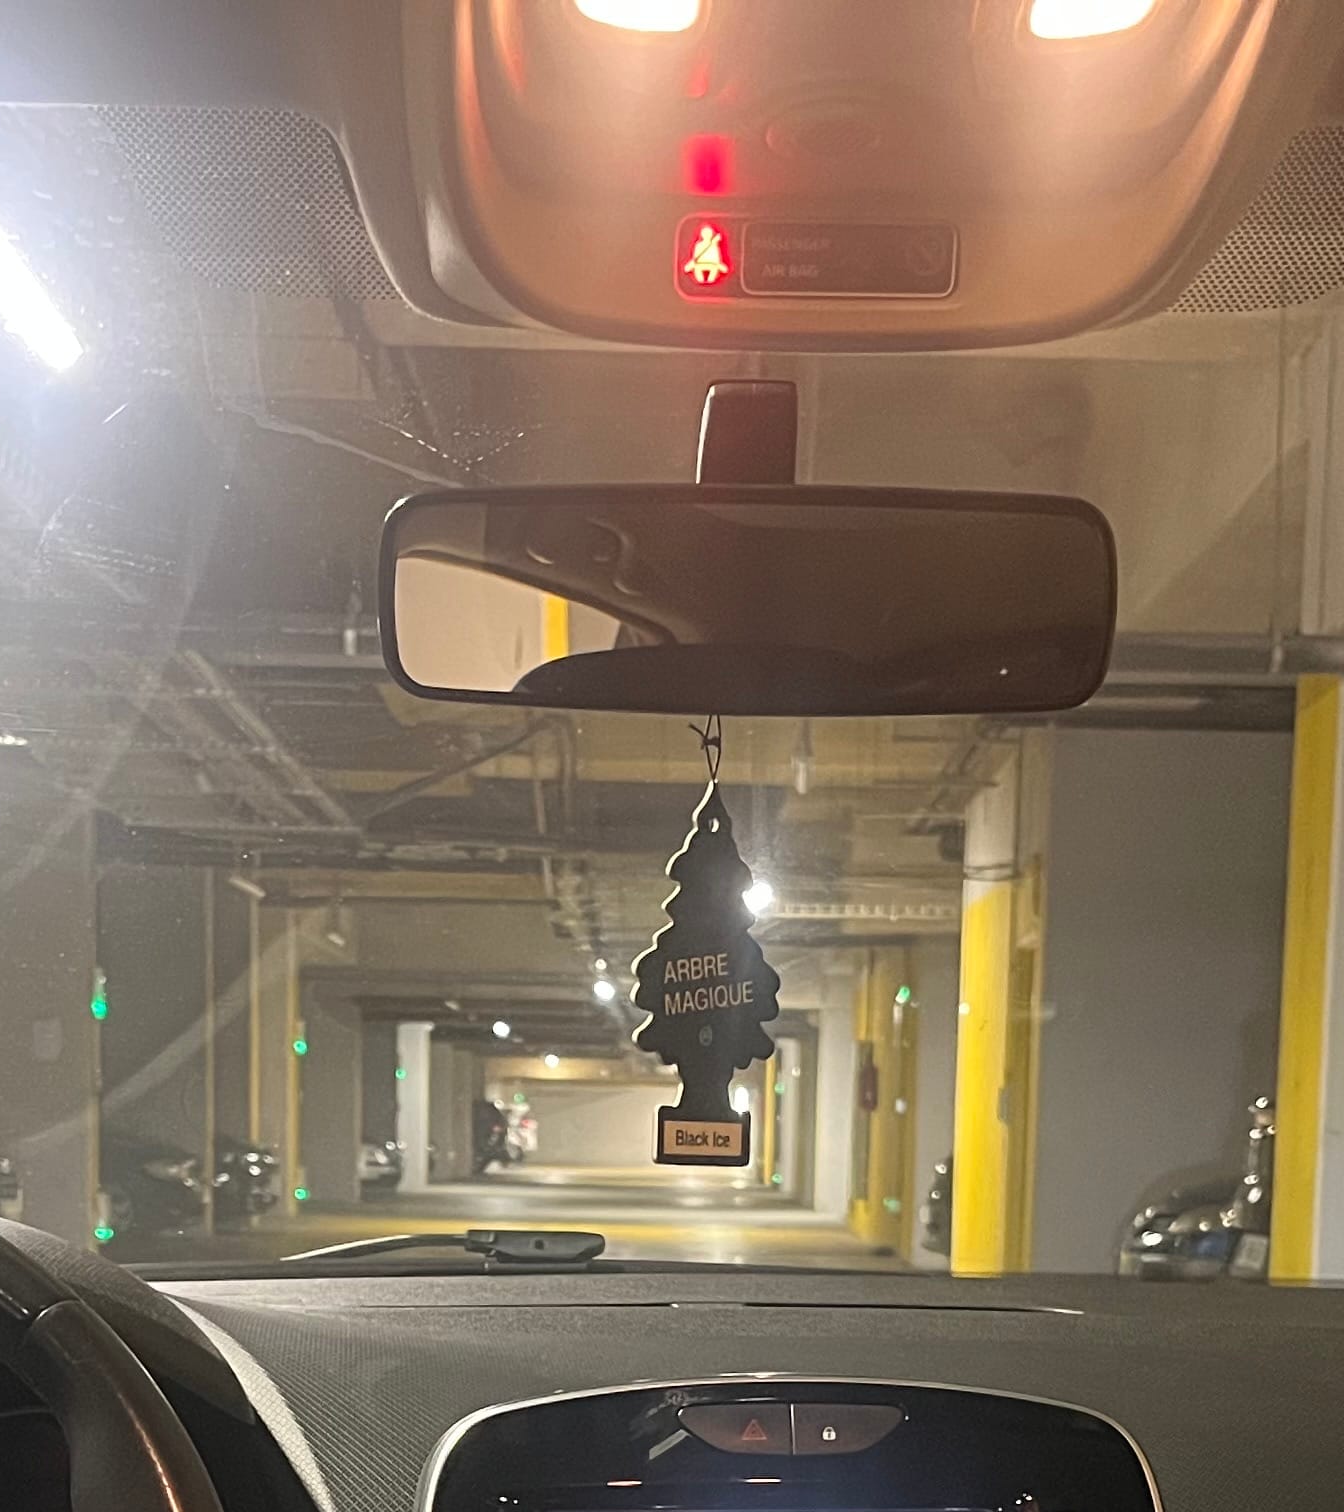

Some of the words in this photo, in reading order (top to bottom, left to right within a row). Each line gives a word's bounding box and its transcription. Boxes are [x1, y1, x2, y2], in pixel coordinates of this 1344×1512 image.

[663, 953, 729, 985] ARBRE
[664, 981, 754, 1016] MAGIQUE
[675, 1129, 709, 1147] Black
[712, 1131, 731, 1148] Ice
